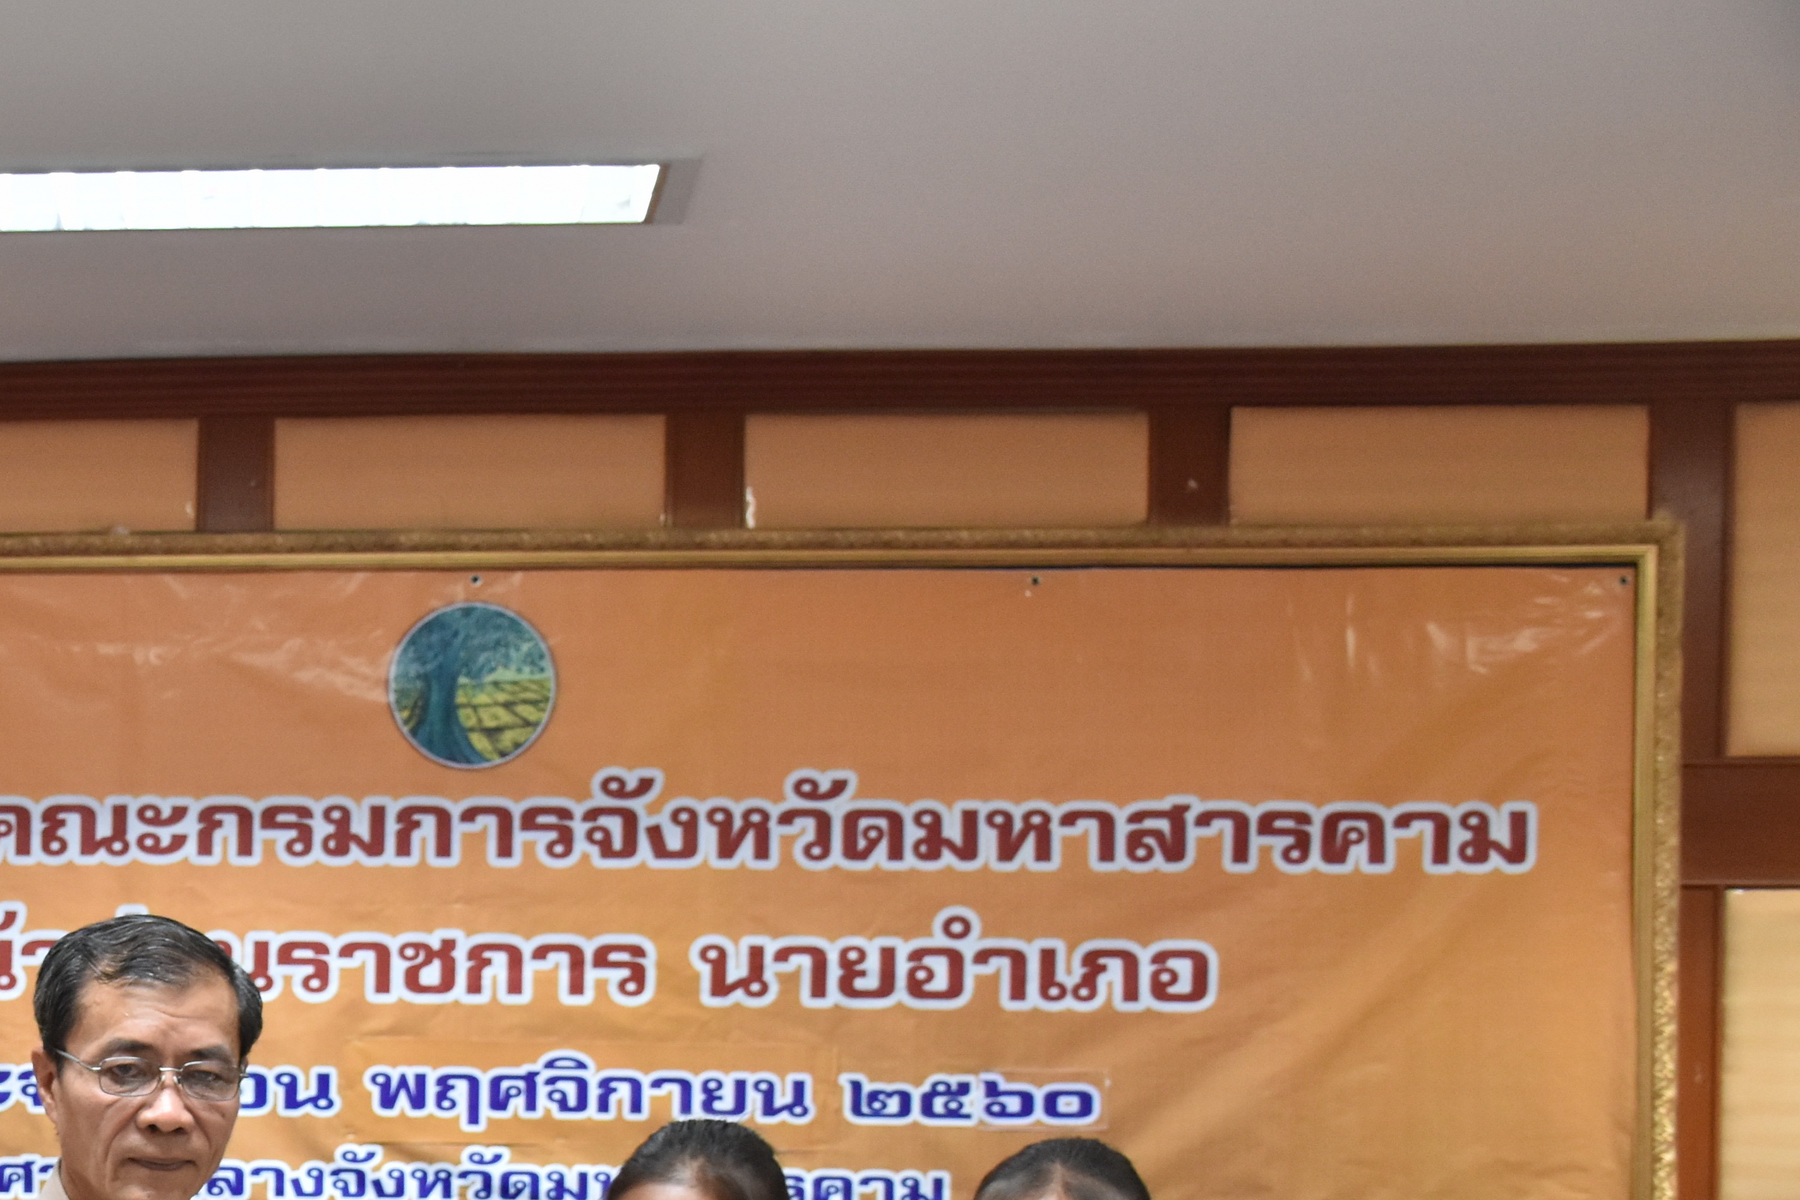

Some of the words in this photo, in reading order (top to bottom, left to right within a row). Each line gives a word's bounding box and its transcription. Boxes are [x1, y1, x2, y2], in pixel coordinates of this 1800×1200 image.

[698, 906, 1215, 1010] นายอำเภอ
[370, 1050, 812, 1130] พฤศจิกายน
[848, 1074, 1098, 1125] ๒๕๖๐
